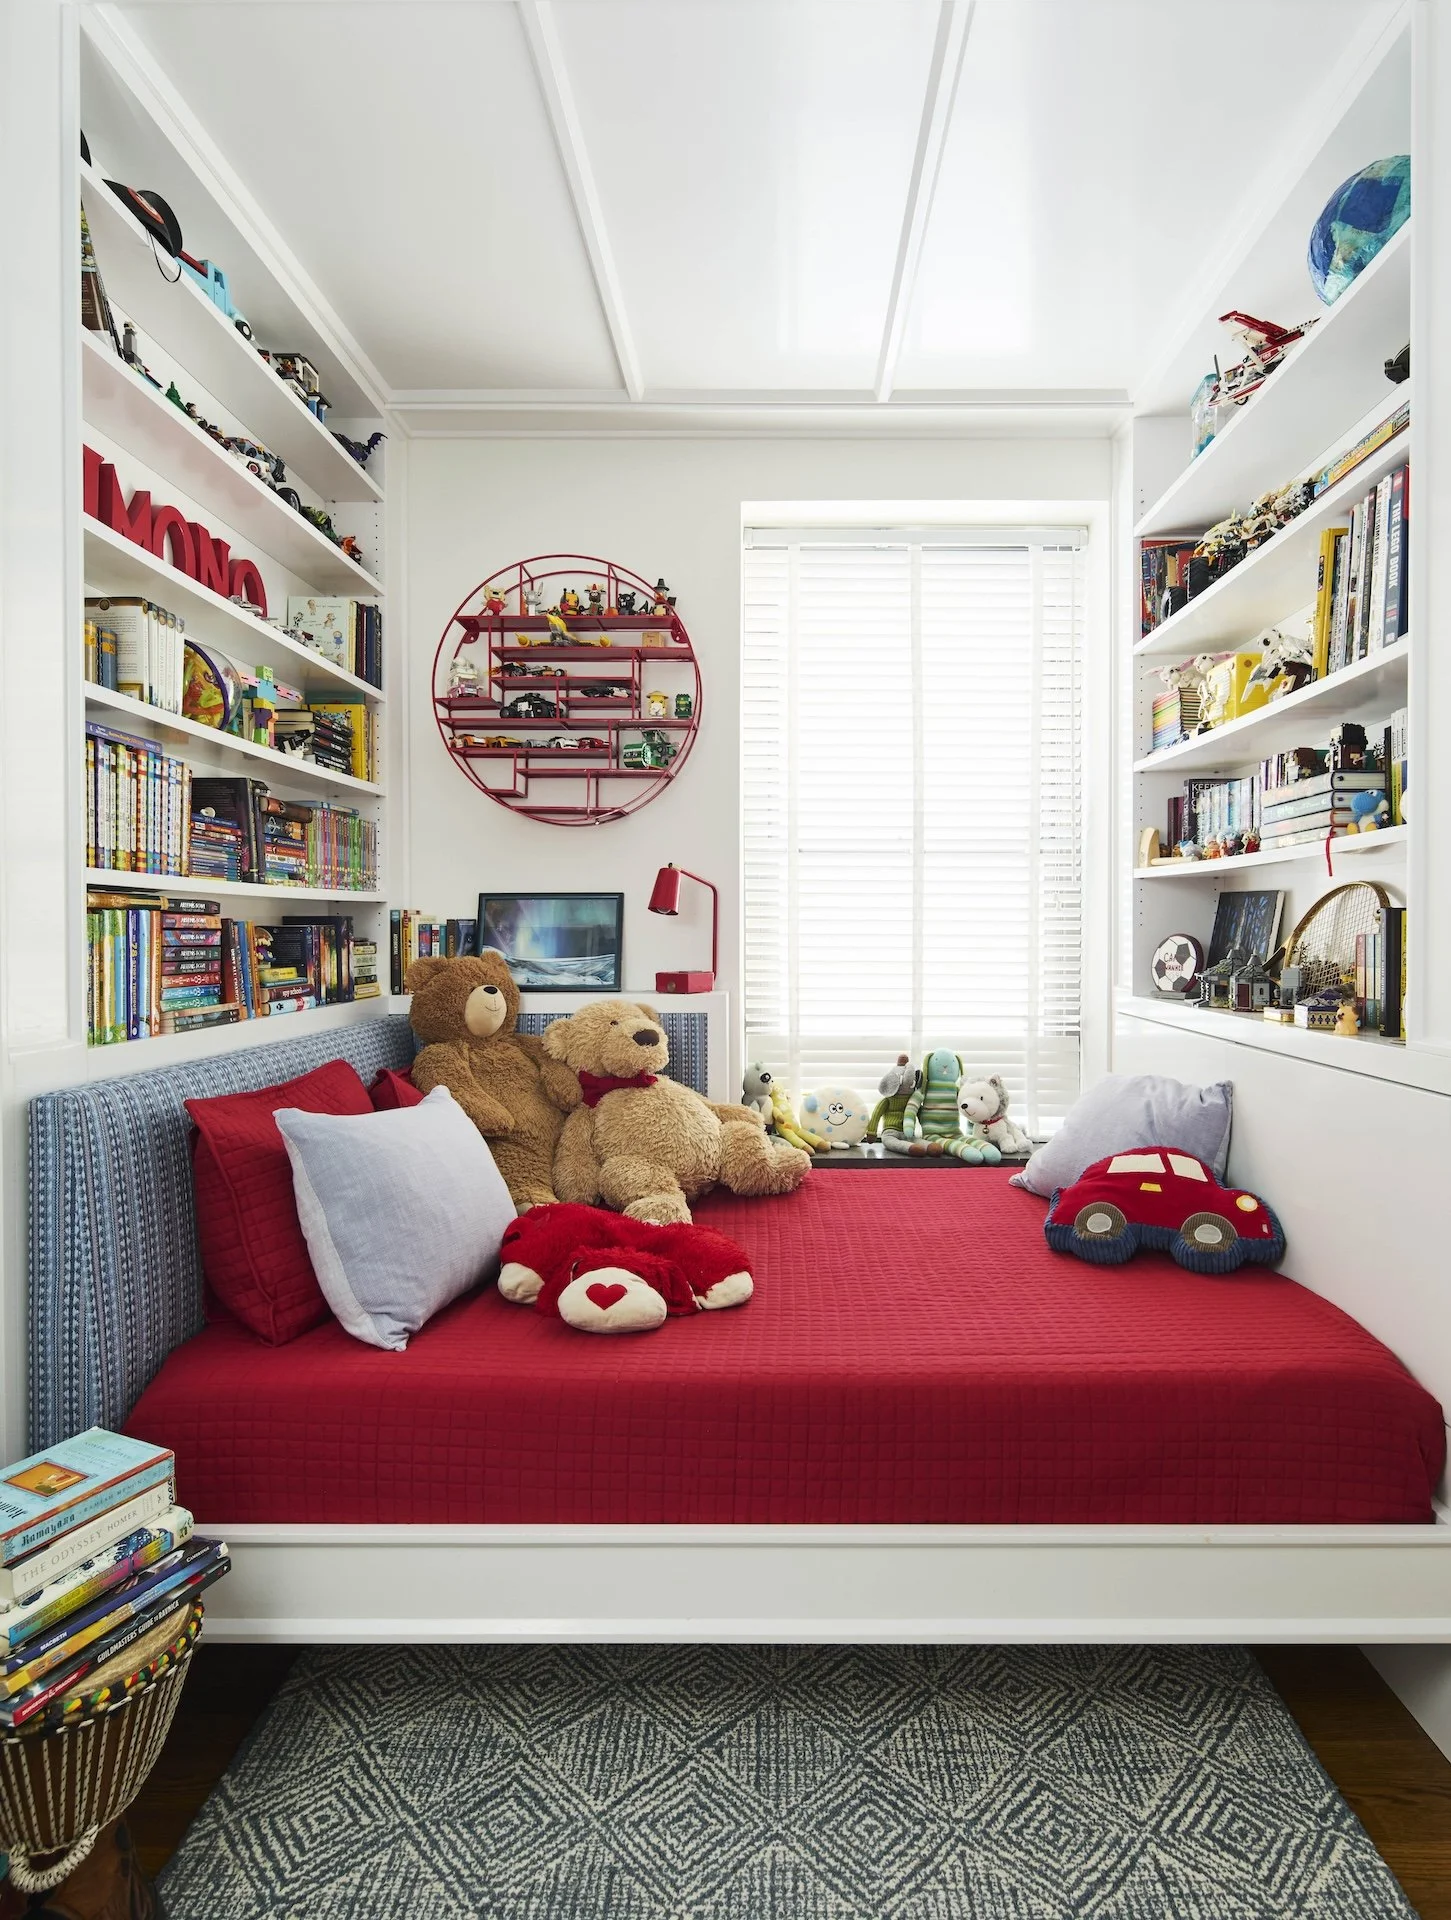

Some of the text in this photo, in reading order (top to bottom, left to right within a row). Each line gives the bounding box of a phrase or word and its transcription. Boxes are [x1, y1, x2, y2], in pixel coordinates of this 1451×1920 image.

[1389, 500, 1401, 589] THE LEGO BOOK
[21, 1513, 75, 1547] Ramayana
[21, 1510, 138, 1583] THE ODYSSEY HOMER
[40, 1631, 67, 1651] MACBETH
[97, 1627, 138, 1663] GUILDMASTERS'
[138, 1618, 154, 1634] GUIDE
[158, 1600, 179, 1619] RAVNICA
[21, 1695, 48, 1716] DUNGEONS
